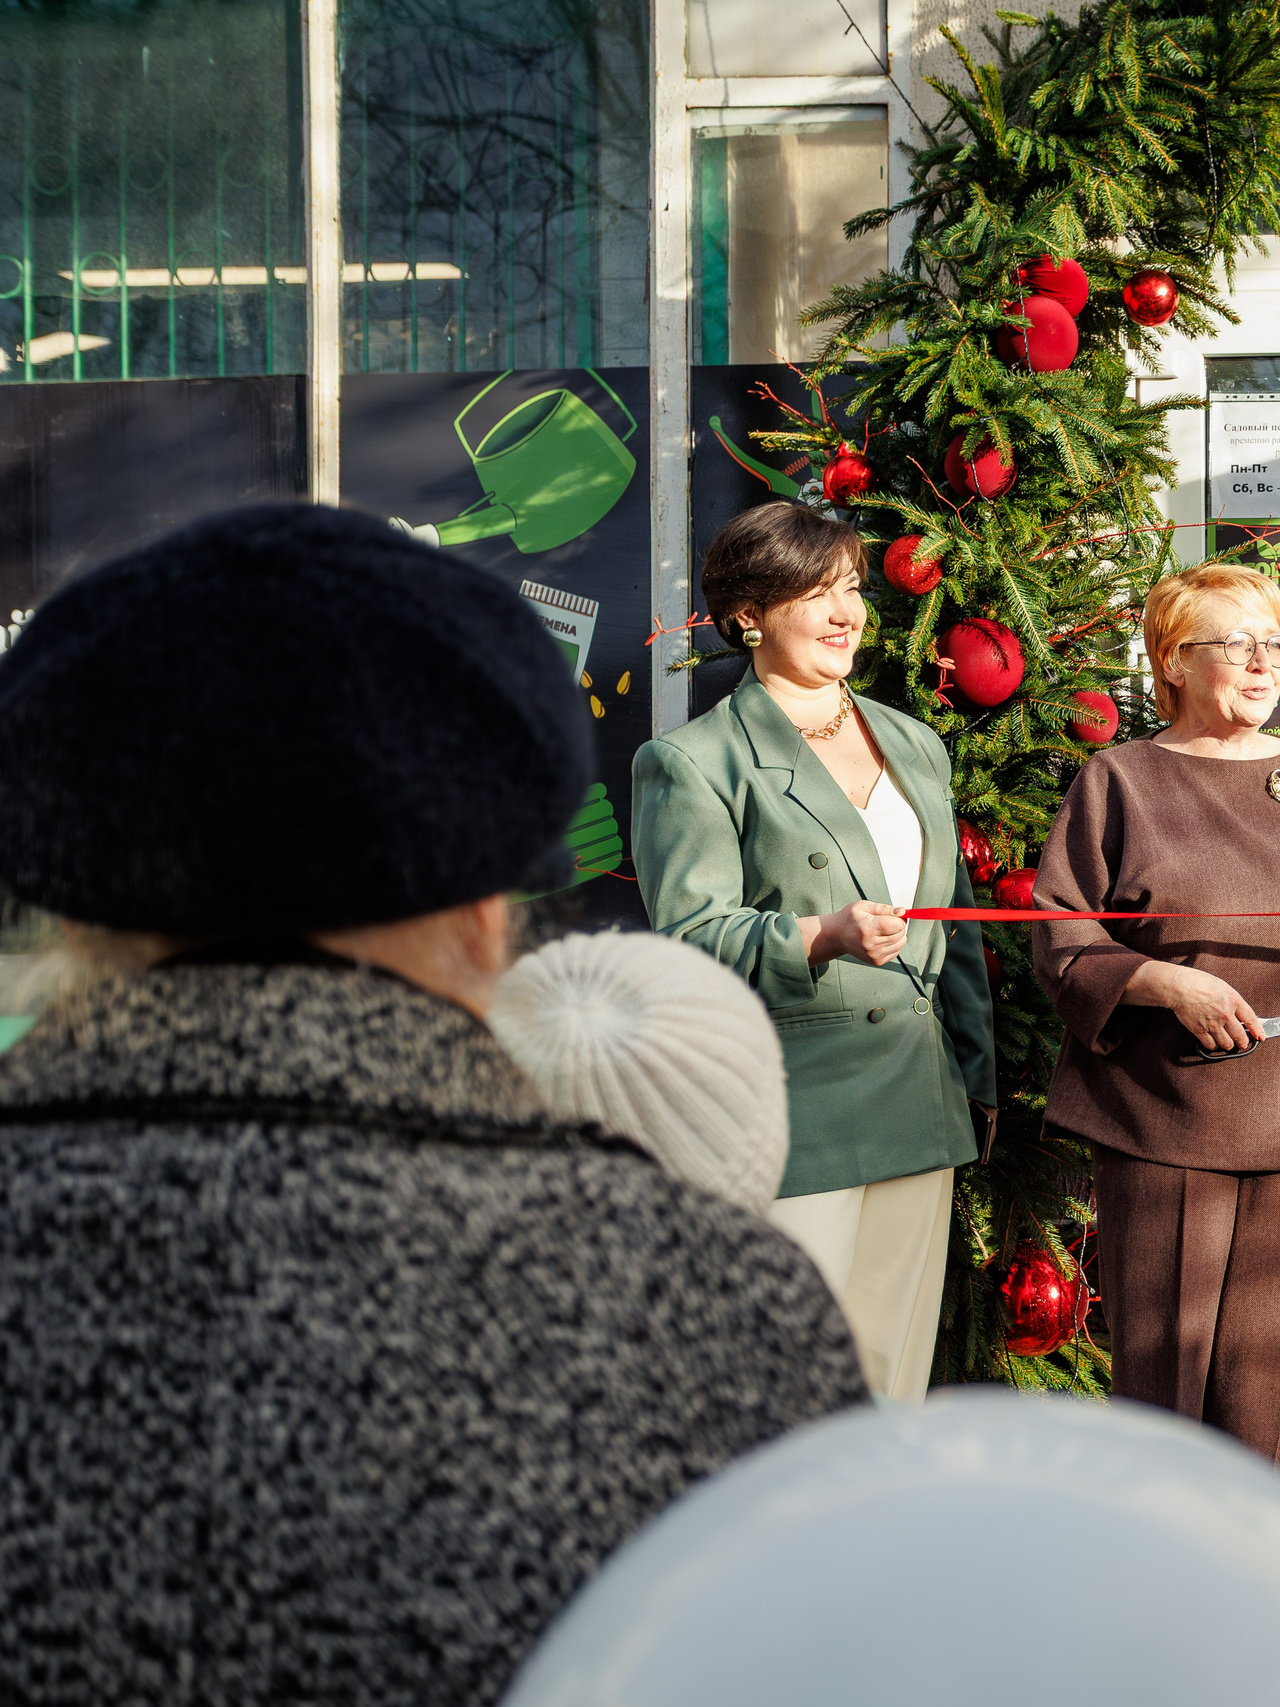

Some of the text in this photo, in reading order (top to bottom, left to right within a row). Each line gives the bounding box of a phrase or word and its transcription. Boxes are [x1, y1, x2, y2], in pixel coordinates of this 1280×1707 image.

[1224, 422, 1268, 432] Садовый
[1230, 437, 1270, 445] временно
[1230, 463, 1268, 474] Пн-Пт
[1232, 483, 1252, 494] Сб,
[1257, 482, 1274, 493] Вс
[537, 614, 578, 637] ЕМЕНА
